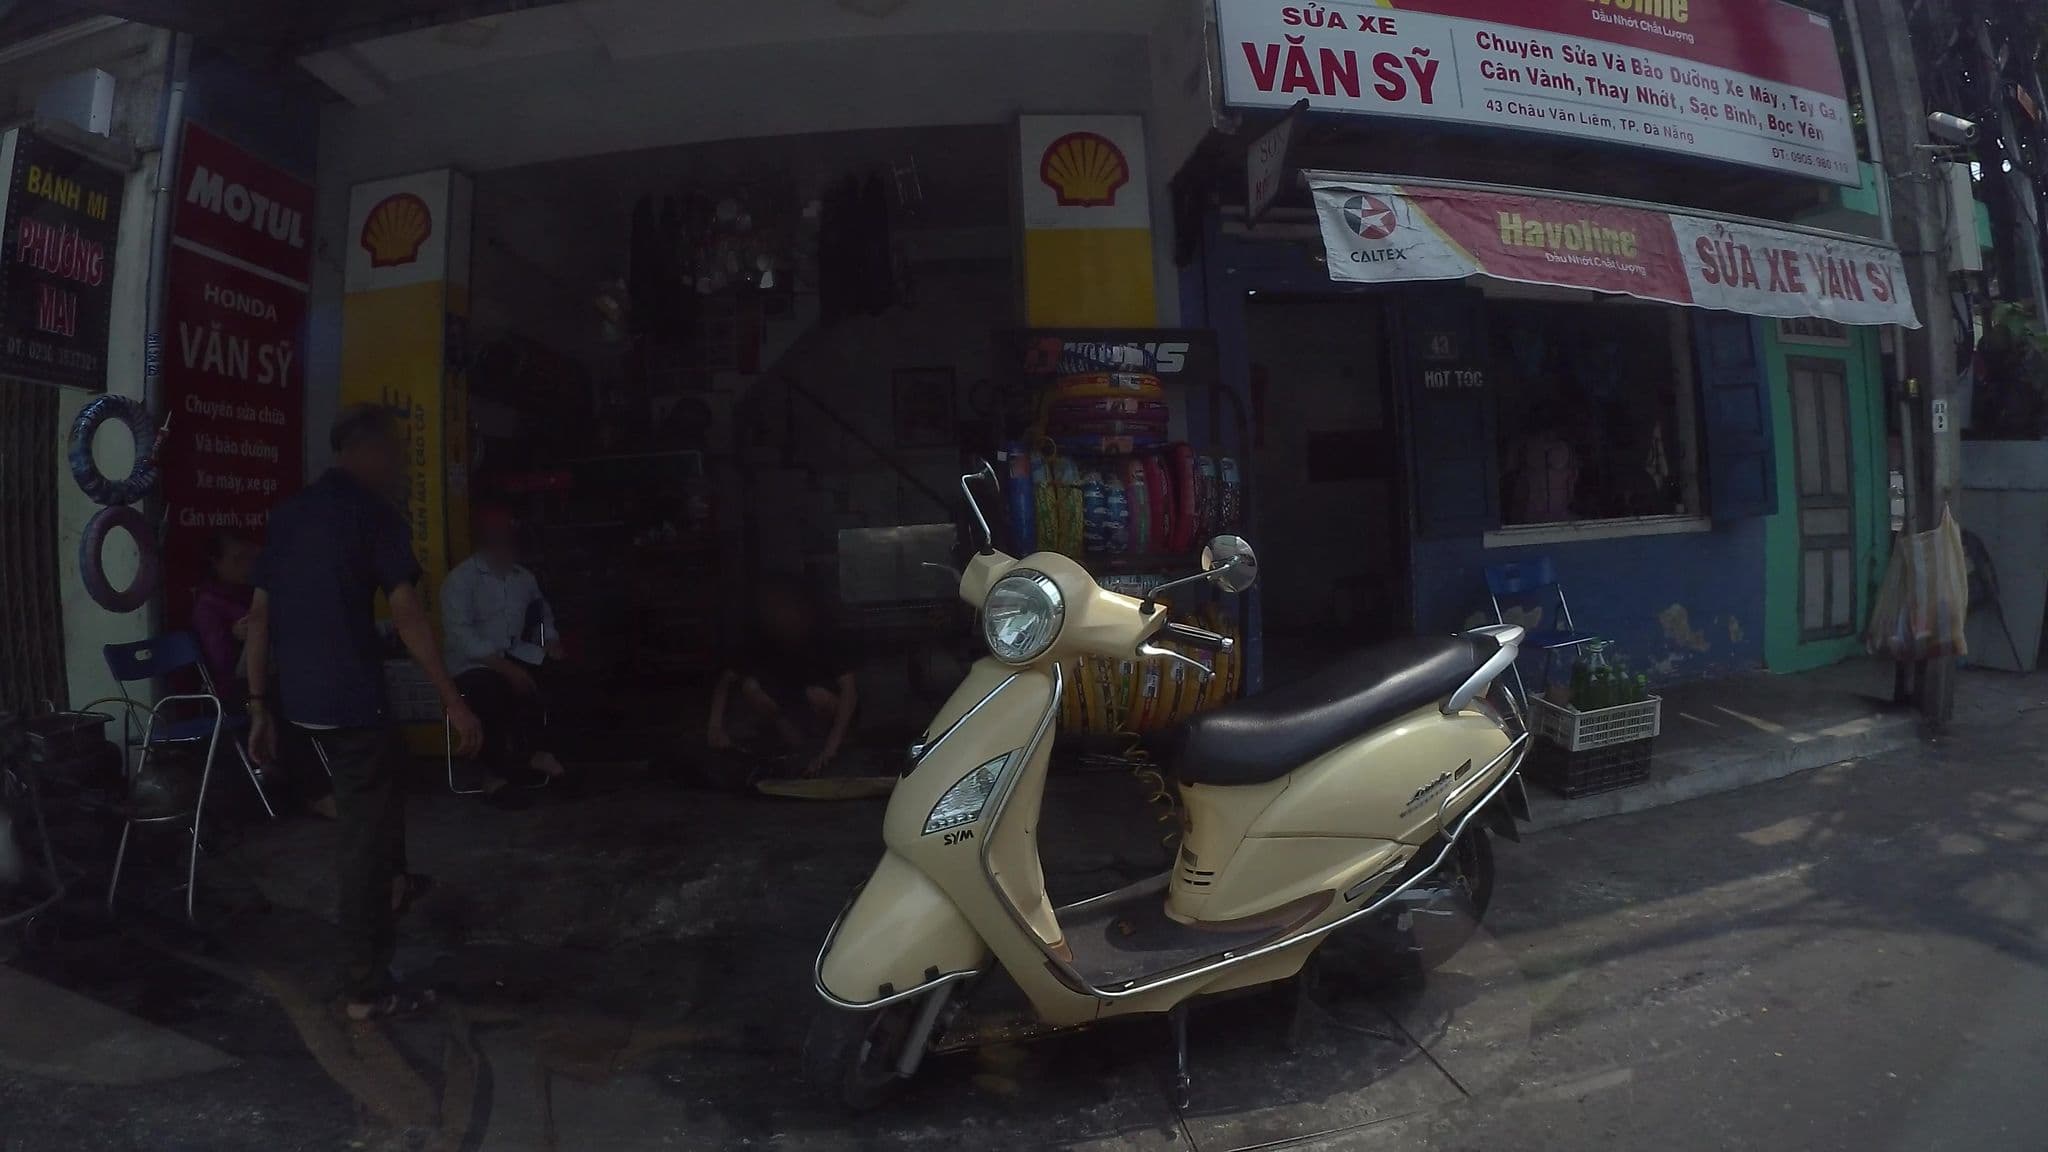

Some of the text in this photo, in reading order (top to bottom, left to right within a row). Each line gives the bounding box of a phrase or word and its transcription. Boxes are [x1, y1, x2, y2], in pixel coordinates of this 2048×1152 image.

[1281, 2, 1398, 36] SỬA XE
[1241, 33, 1440, 105] VĂN SỸ
[1475, 30, 1554, 59] Chuyên
[1561, 44, 1598, 68] Sửa
[1602, 51, 1626, 73] Và
[1630, 56, 1664, 81] Bảo
[1724, 78, 1745, 98] Xe
[1789, 93, 1815, 118] Tay
[1479, 59, 1521, 84] Cân
[1584, 75, 1629, 103] Thay
[1689, 96, 1719, 121] Sạc
[1767, 113, 1794, 137] Bọc
[1797, 119, 1825, 142] Yên
[1486, 98, 1504, 113] 43
[1506, 101, 1546, 119] Châu
[1619, 117, 1640, 133] TP.
[1643, 122, 1660, 137] Đà
[185, 163, 305, 249] MOTUL
[1349, 247, 1407, 263] CALTEX
[1497, 210, 1638, 258] Havoline
[1694, 222, 1761, 290] SỬA
[1763, 246, 1807, 294] XE
[203, 282, 279, 323] HONDA
[179, 319, 250, 382] VĂN
[255, 339, 294, 390] SỸ
[185, 393, 233, 421] Chuyên
[195, 469, 213, 489] Xe
[247, 477, 261, 490] xe
[943, 829, 974, 846] SYM
